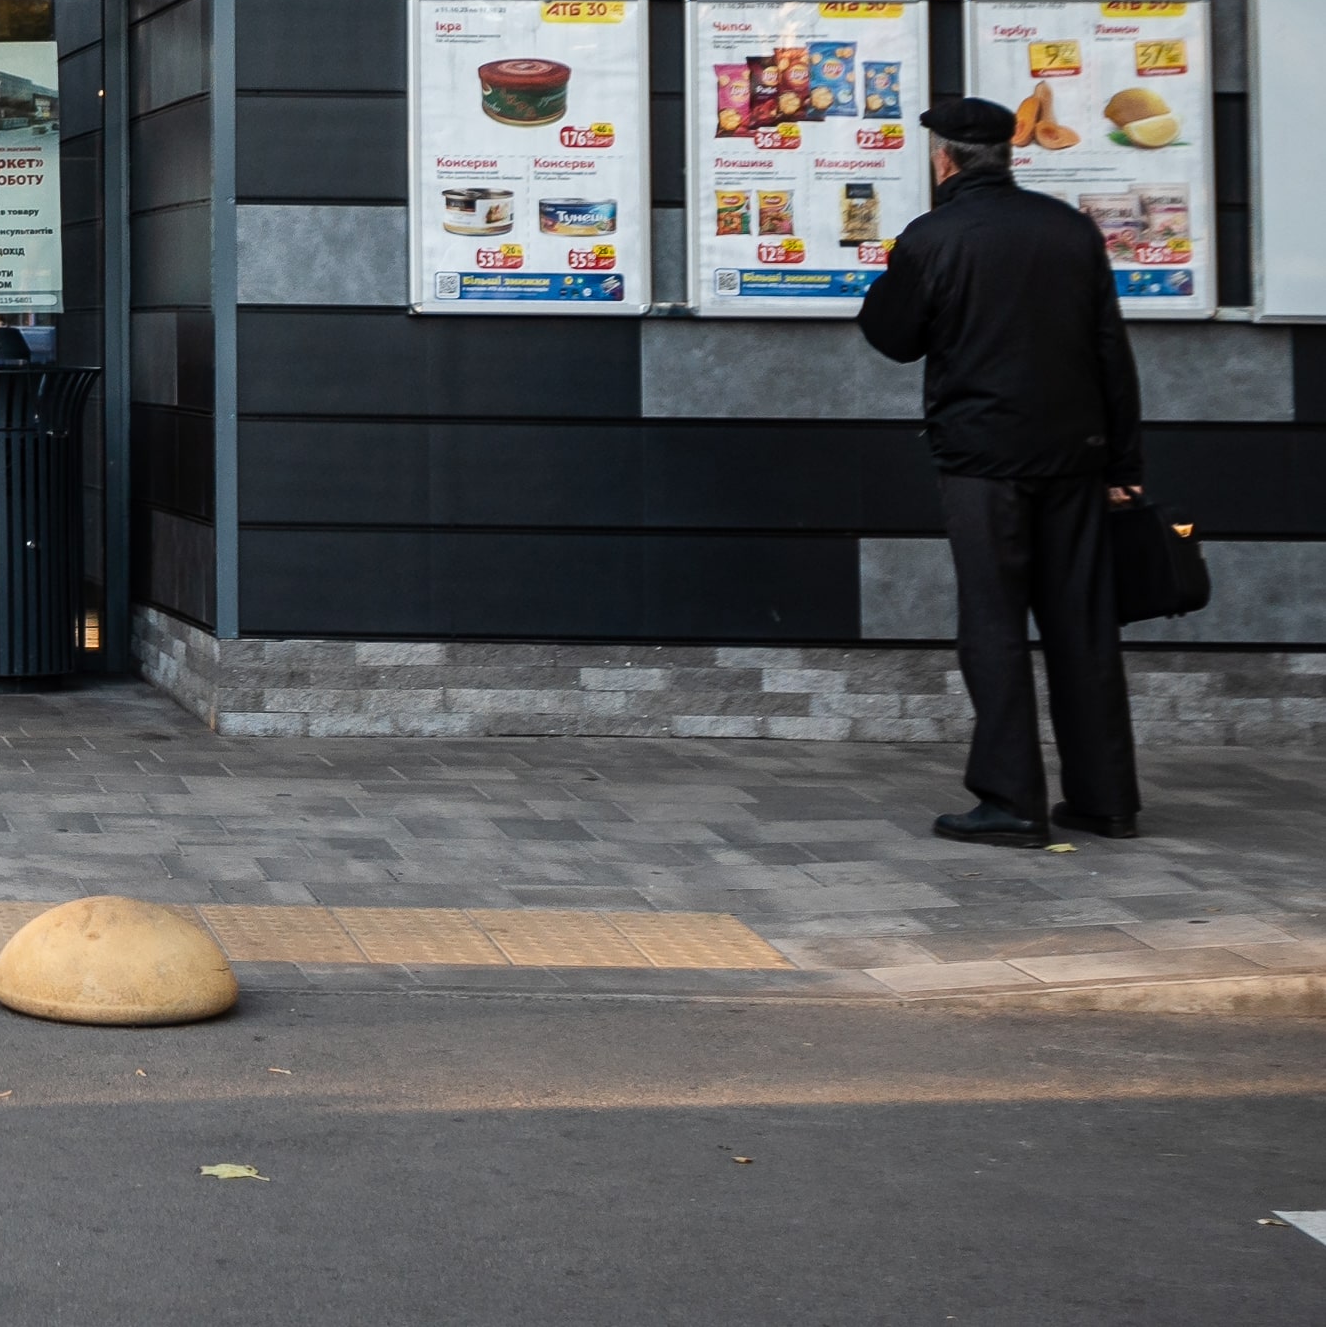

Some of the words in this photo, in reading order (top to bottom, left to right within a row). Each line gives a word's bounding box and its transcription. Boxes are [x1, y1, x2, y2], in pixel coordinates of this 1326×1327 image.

[546, 2, 583, 16] АТБ
[586, 2, 608, 16] 30
[435, 21, 462, 33] Ікра
[713, 21, 752, 32] Чипси
[437, 157, 498, 170] Консерви
[534, 158, 595, 170] Консерви
[7, 209, 39, 217] товару
